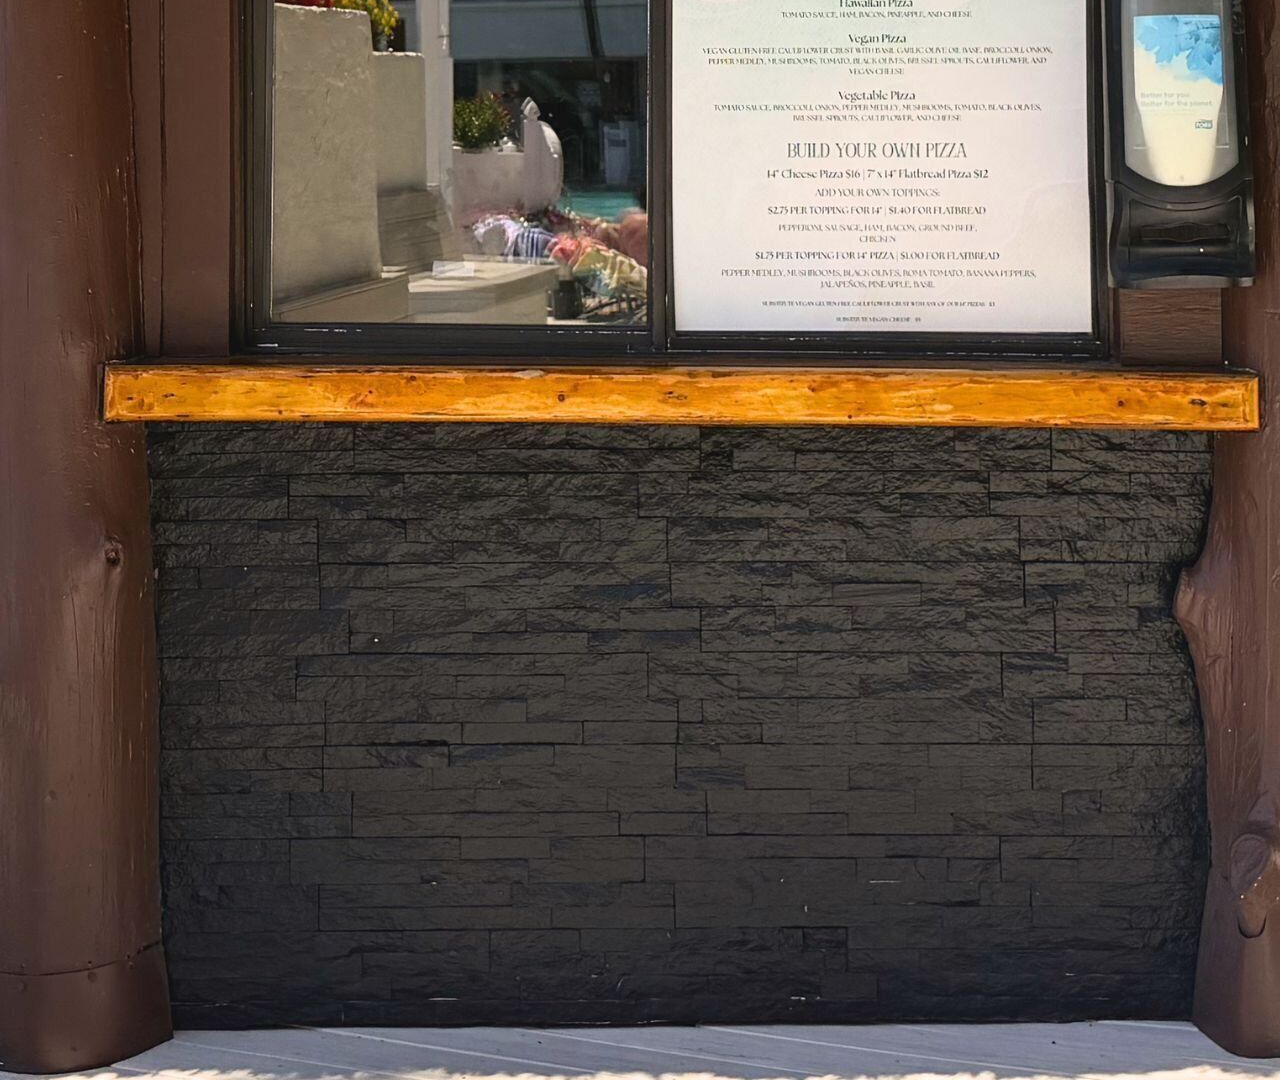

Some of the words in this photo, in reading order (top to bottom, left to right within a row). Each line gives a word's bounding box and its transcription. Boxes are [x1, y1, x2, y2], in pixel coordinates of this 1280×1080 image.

[848, 34, 880, 46] Vegan
[882, 34, 907, 43] Pizza
[838, 90, 888, 103] Vegetable
[891, 90, 916, 100] Pizza
[787, 142, 830, 158] BUILD
[835, 142, 877, 158] YOUR
[882, 142, 920, 158] OWN
[926, 142, 968, 158] PIZZA
[781, 169, 818, 179] Cheese
[819, 169, 844, 179] Pizza
[845, 169, 860, 179] $16
[898, 169, 946, 179] Flatbread
[948, 169, 972, 179] Pizza
[973, 169, 989, 179] $12
[815, 188, 836, 197] ADD
[837, 188, 864, 197] YOUR
[865, 188, 890, 197] OWN
[892, 188, 940, 197] TOPPINGS:
